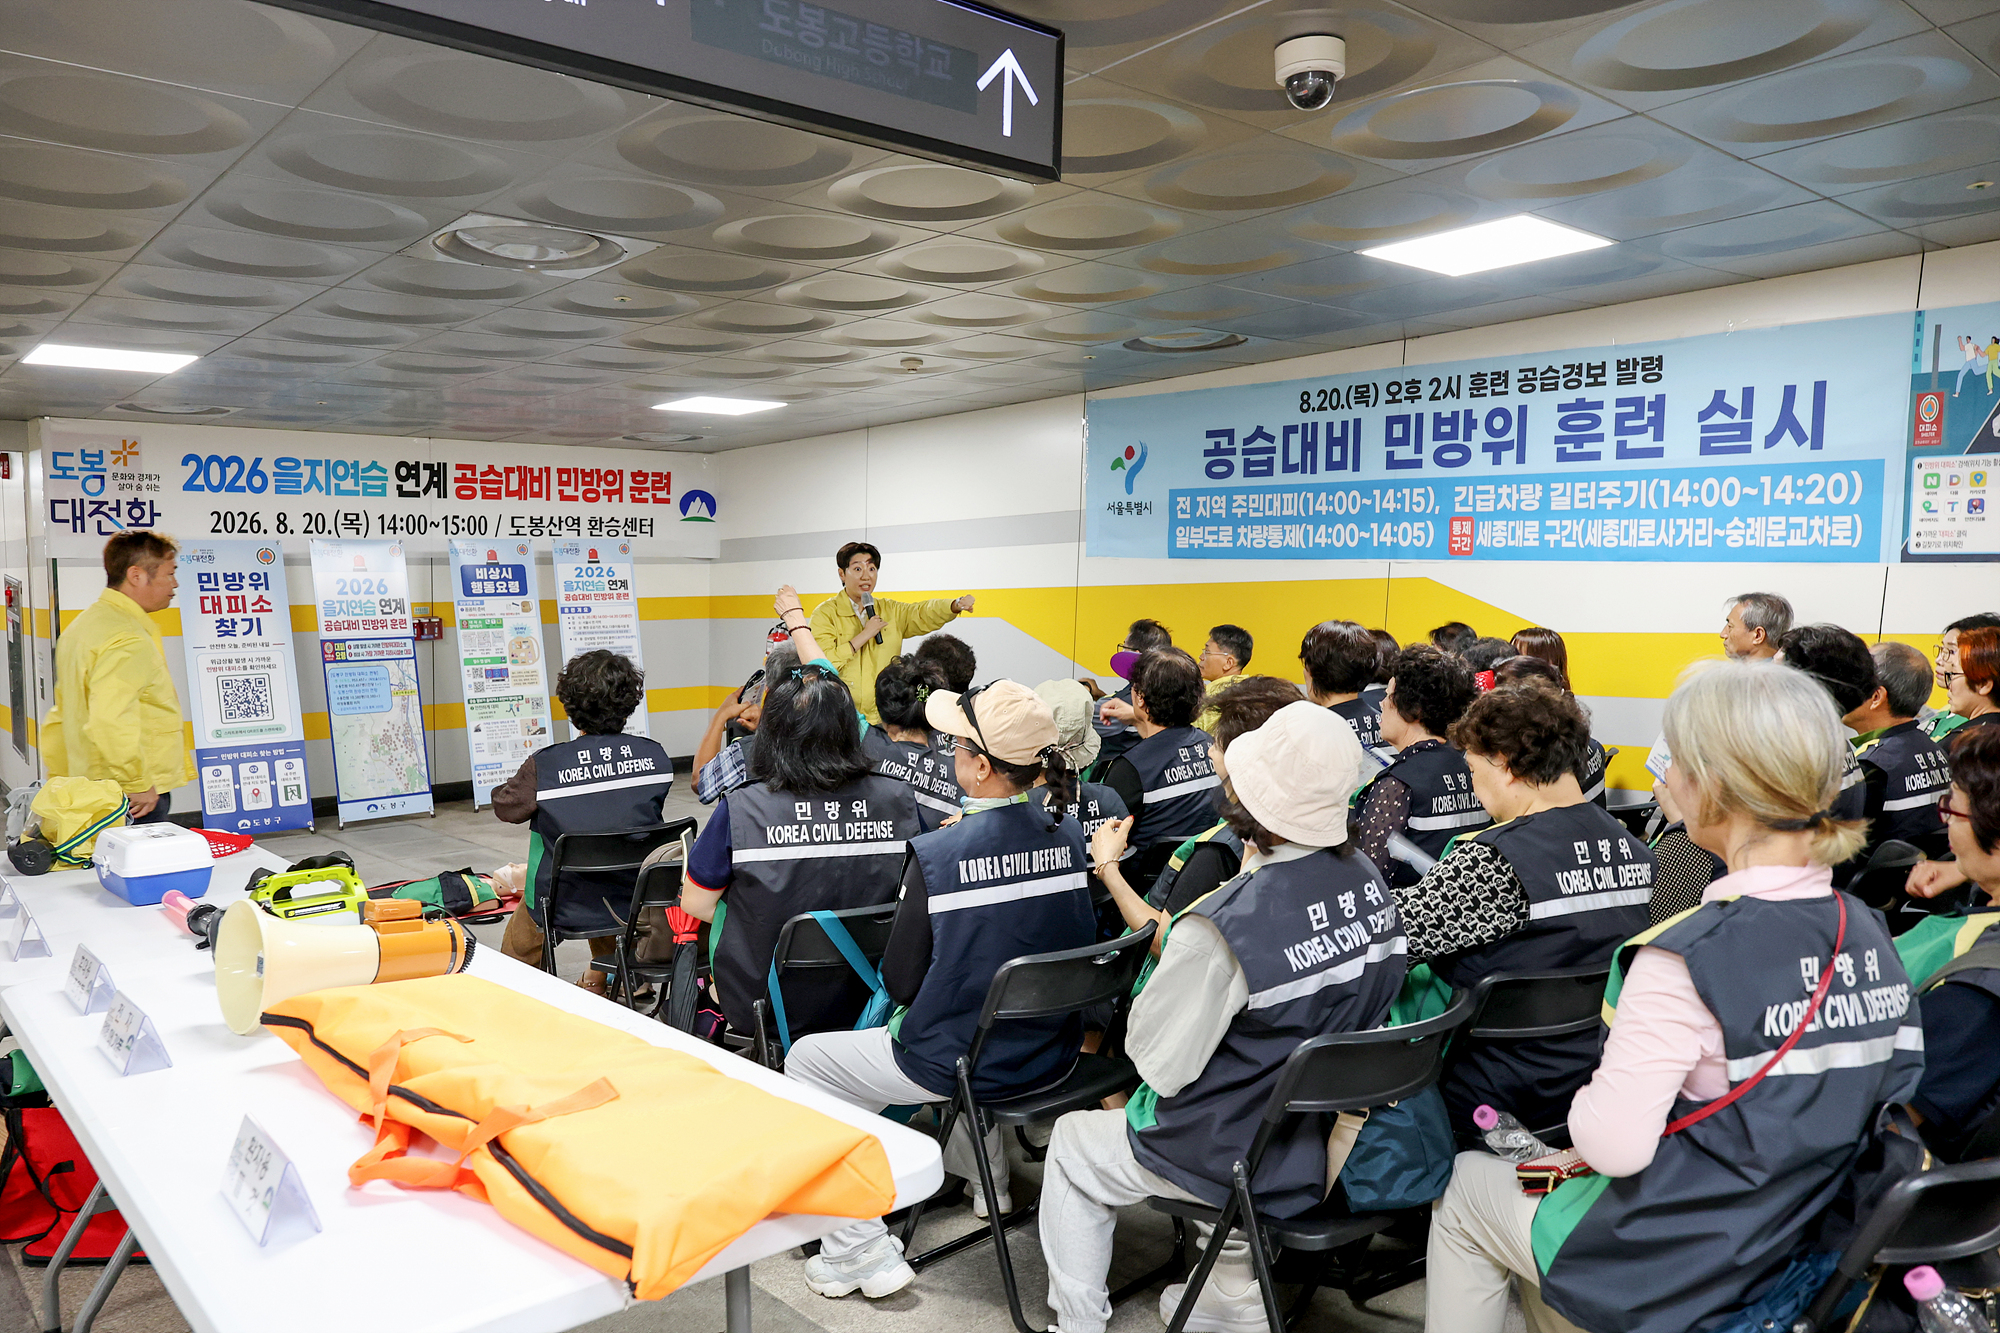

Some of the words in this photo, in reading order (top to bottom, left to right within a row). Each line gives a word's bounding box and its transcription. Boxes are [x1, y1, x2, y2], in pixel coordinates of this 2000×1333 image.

[762, 38, 822, 72] Dobong
[826, 56, 859, 79] High
[1299, 383, 1380, 414] 8.20.(목)
[1385, 379, 1422, 405] 오후
[1428, 374, 1462, 401] 2시
[1468, 369, 1510, 398] 훈련
[1517, 361, 1607, 393] 공습경보
[1616, 355, 1664, 385] 발령
[1203, 417, 1362, 480] 공습대비
[1384, 404, 1528, 471] 민방위
[1553, 394, 1667, 463] 훈련
[1697, 380, 1828, 456] 실시
[1918, 424, 1938, 432] 대피소
[50, 448, 107, 497] 도봉
[111, 472, 136, 483] 문화와
[137, 472, 161, 483] 경제가
[181, 453, 269, 494] 2026
[272, 456, 389, 497] 을지연습
[395, 460, 448, 499] 연계
[454, 463, 551, 501] 공습대비
[556, 467, 624, 503] 민방위
[629, 469, 672, 505] 훈련
[117, 482, 135, 492] 살아
[135, 482, 143, 492] 숨
[145, 482, 161, 492] 쉬는
[1106, 500, 1152, 516] 서울특별시
[1176, 495, 1191, 519] 전
[1195, 494, 1227, 519] 지역
[1454, 483, 1541, 513] 긴급차량
[210, 510, 268, 535] 2026.
[276, 512, 294, 535] 8.
[302, 509, 370, 538] 20.(목)
[378, 513, 488, 536] 14:00~15:00
[508, 515, 581, 538] 도봉산역
[587, 515, 655, 538] 환승센터
[1452, 520, 1472, 536] 통제
[1476, 519, 1540, 548] 세종대로
[1175, 525, 1233, 550] 일부도로
[1452, 536, 1472, 551] 구간
[197, 572, 270, 592] 민방위
[475, 567, 513, 580] 비상시
[574, 566, 615, 578] 2026
[335, 578, 389, 596] 2026
[471, 581, 520, 594] 행동요령
[563, 580, 605, 592] 을지연습
[608, 579, 629, 591] 연계
[199, 595, 273, 614] 대피소
[564, 593, 592, 602] 공습대비
[593, 593, 614, 601] 민방위
[616, 592, 629, 600] 훈련
[322, 599, 377, 617] 을지연습
[379, 598, 406, 615] 연계
[215, 617, 262, 637] 찾기
[324, 619, 360, 632] 공습대비
[362, 618, 388, 631] 민방위
[390, 618, 408, 630] 훈련
[558, 767, 591, 784] KOREA
[592, 762, 616, 778] CIVIL
[617, 757, 656, 774] DEFENSE
[879, 758, 912, 782] KOREA
[911, 770, 930, 789] CIVIL
[929, 777, 958, 801] DEFENSE
[1164, 765, 1195, 784] KOREA
[1904, 772, 1933, 792] KOREA
[1431, 795, 1459, 815] KOREA
[766, 824, 810, 845] KOREA
[812, 822, 843, 842] CIVIL
[845, 820, 894, 841] DEFENSE
[958, 857, 1001, 884] KOREA
[1001, 852, 1031, 878] CIVIL
[1032, 845, 1073, 874] DEFENSE
[1555, 868, 1594, 895] KOREA
[1592, 865, 1618, 891] CIVIL
[1284, 933, 1341, 973] KOREA
[1333, 920, 1372, 953] CIVIL
[1824, 992, 1868, 1029] CIVIL
[1862, 982, 1911, 1023] DEFENSE
